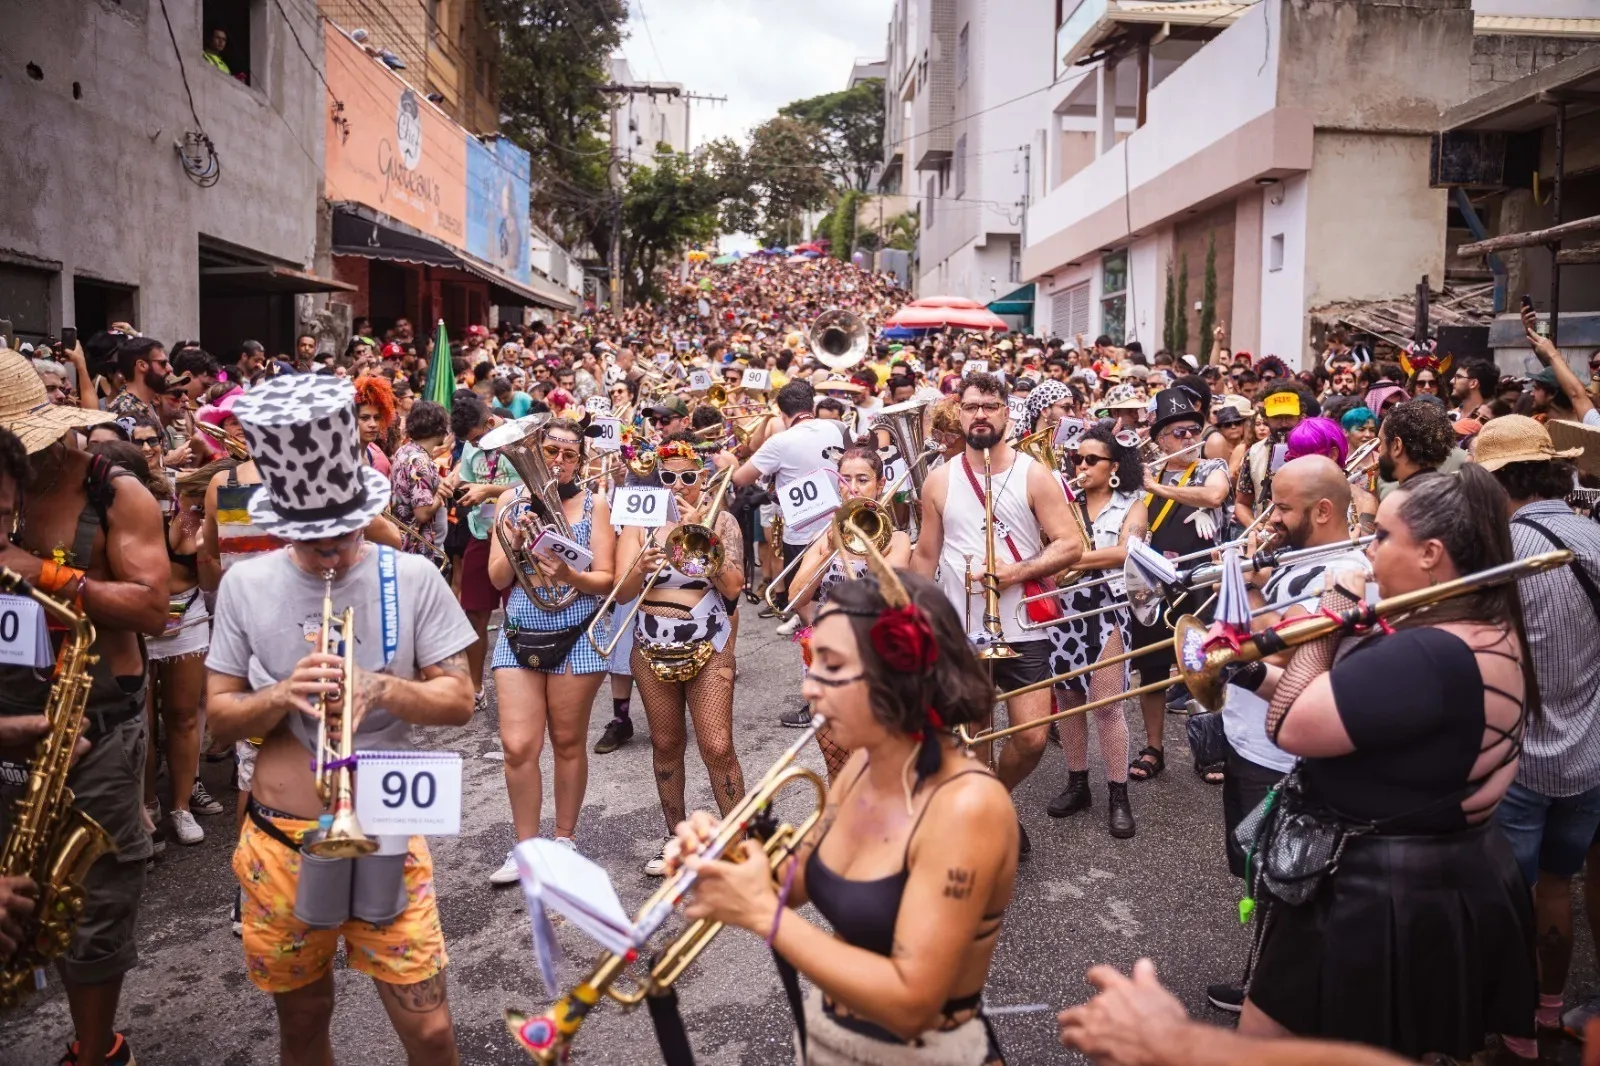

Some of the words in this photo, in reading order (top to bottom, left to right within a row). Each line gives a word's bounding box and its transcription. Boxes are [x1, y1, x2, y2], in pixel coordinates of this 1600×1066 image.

[694, 375, 705, 385] 90
[748, 371, 761, 383] 90
[1008, 401, 1024, 413] 90
[601, 424, 614, 440] 90
[884, 465, 895, 481] 0
[788, 480, 818, 507] 90
[626, 493, 656, 515] 90
[550, 543, 579, 561] 90
[383, 580, 398, 647] CARNAVAL
[0, 610, 19, 643] 0
[381, 770, 437, 809] 90
